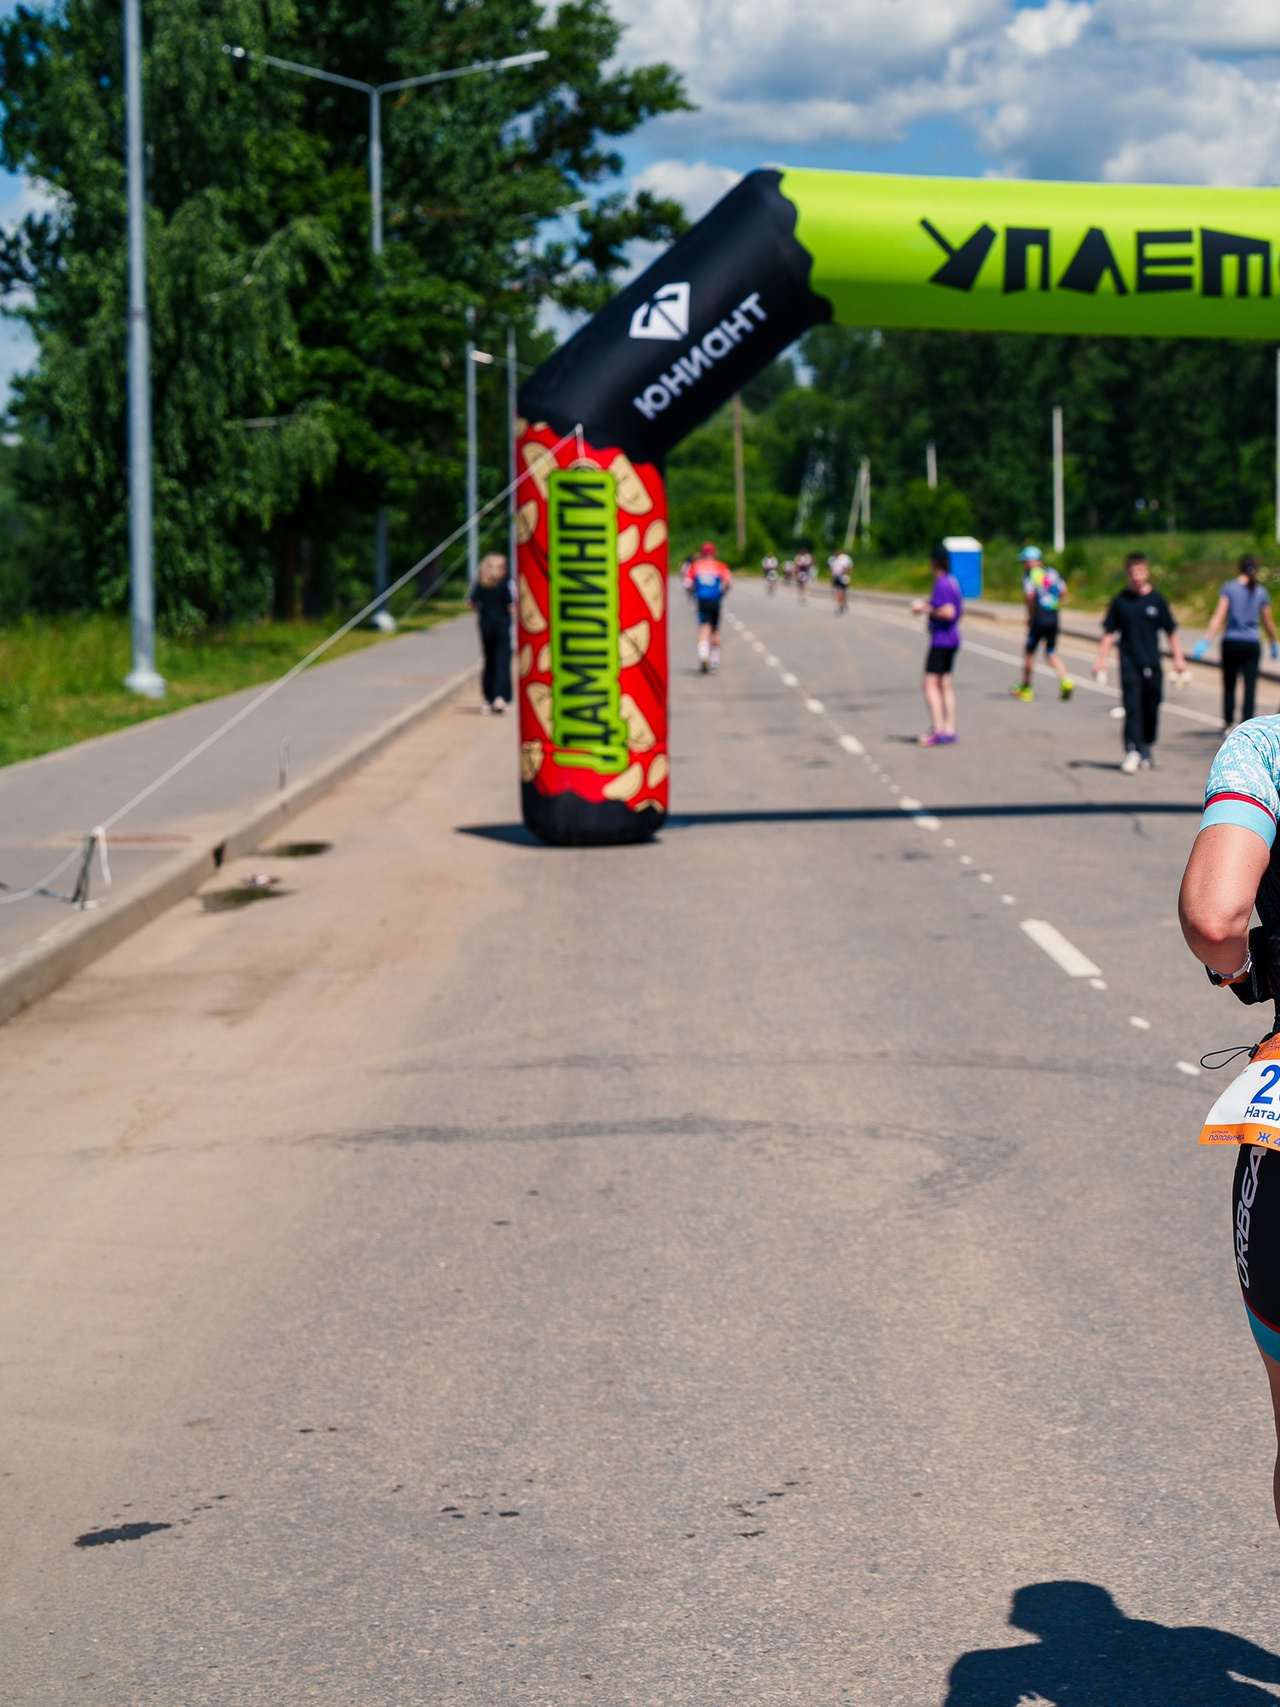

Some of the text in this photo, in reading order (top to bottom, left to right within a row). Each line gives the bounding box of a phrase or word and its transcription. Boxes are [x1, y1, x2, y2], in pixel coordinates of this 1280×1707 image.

[557, 480, 618, 763] ДАМПЛИНГИ
[1256, 1131, 1272, 1144] Ж
[1236, 1146, 1269, 1289] ORBEA
